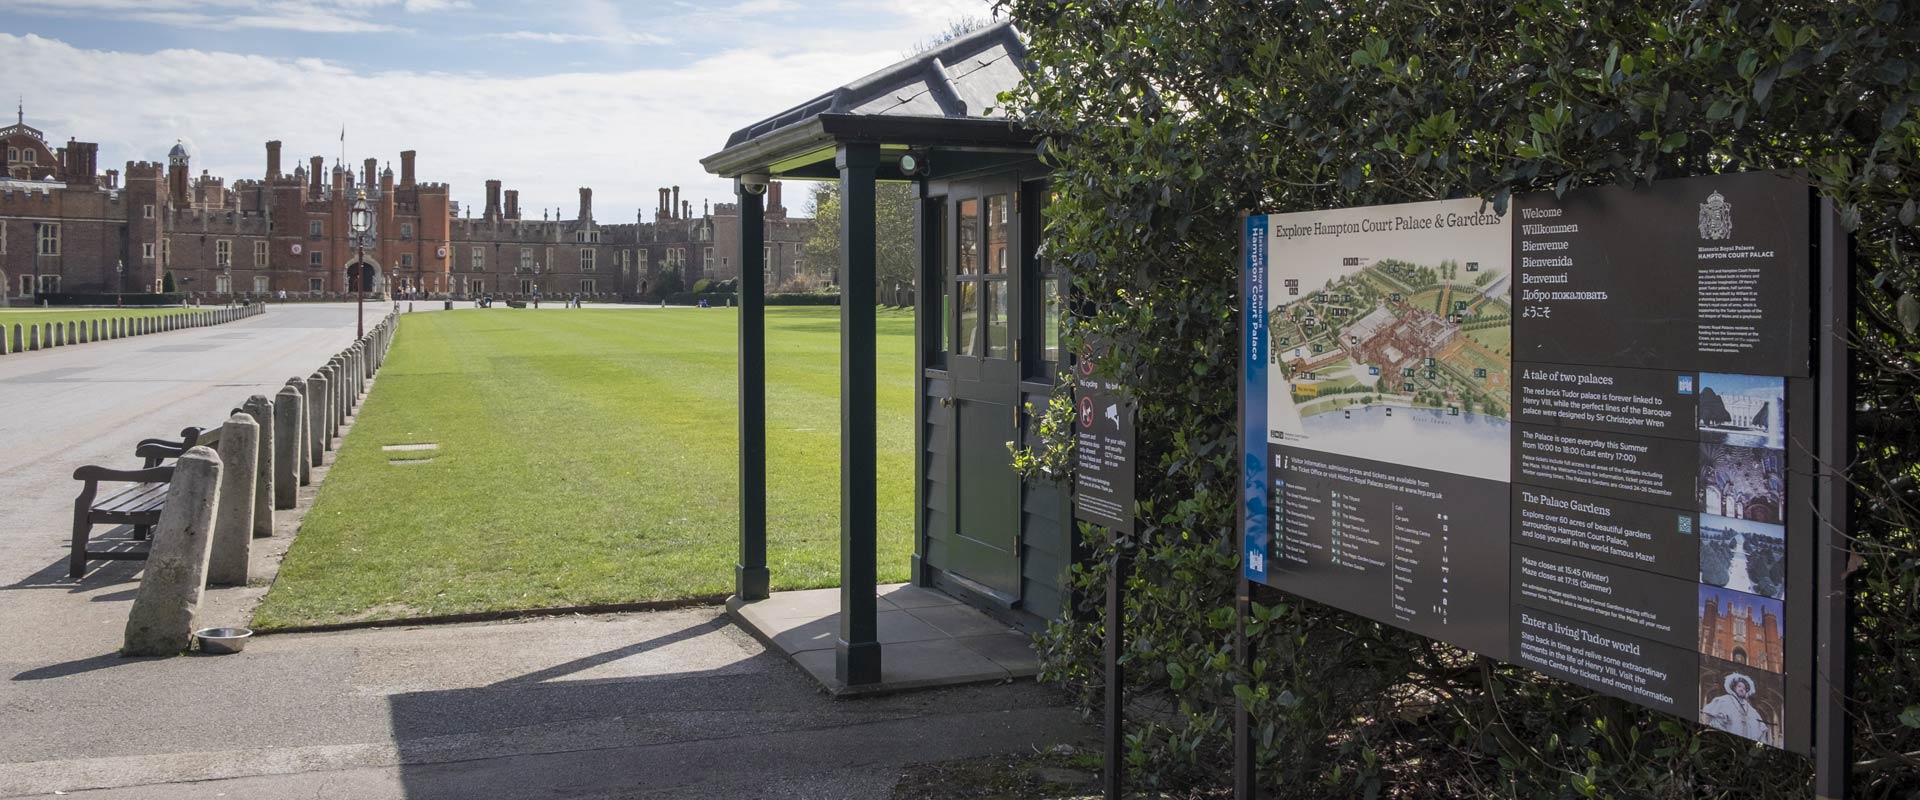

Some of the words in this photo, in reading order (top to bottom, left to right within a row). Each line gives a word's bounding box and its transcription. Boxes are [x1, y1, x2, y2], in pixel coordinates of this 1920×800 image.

[1522, 208, 1562, 219] Welcome
[1277, 224, 1312, 240] Explore
[1314, 222, 1359, 237] Hampton
[1362, 219, 1392, 232] Court
[1395, 216, 1432, 230] Palace
[1435, 214, 1444, 228] &
[1447, 212, 1501, 227] Gardens
[1522, 224, 1578, 235] Willkommen
[1522, 241, 1568, 251] Bienvenue
[1522, 256, 1573, 267] Bienvenida
[1522, 272, 1568, 283] Benvenuti
[1522, 290, 1550, 302] Добро
[1552, 291, 1607, 300] пожаловать
[1522, 306, 1551, 318] ようこそ
[1523, 369, 1530, 379] A
[1532, 370, 1548, 380] tale
[1549, 371, 1558, 381] of
[1560, 373, 1576, 382] two
[1578, 374, 1613, 386] palaces
[1546, 388, 1560, 397] brick
[1562, 390, 1579, 398] Tudor
[1581, 392, 1600, 400] palace
[1608, 394, 1632, 402] forever
[1633, 396, 1653, 404] linked
[1522, 397, 1540, 407] Henry
[1582, 403, 1604, 411] perfect
[1605, 404, 1620, 412] lines
[1643, 407, 1672, 418] Baroque
[1558, 410, 1586, 420] designed
[1587, 412, 1594, 422] by
[1596, 413, 1604, 421] Sir
[1606, 414, 1644, 426] Christopher
[1646, 417, 1664, 427] Wren
[1523, 442, 1536, 450] from
[1538, 443, 1554, 452] 10:00
[1563, 446, 1579, 455] 18:00
[1581, 448, 1596, 457] (Last
[1598, 452, 1614, 461] entry
[1616, 452, 1636, 462] 17:00)
[1535, 433, 1553, 441] Palace
[1577, 439, 1605, 449] everyday
[1607, 441, 1618, 449] this
[1620, 442, 1648, 452] Summer
[1522, 492, 1538, 504] The
[1540, 495, 1569, 509] Palace
[1570, 500, 1610, 516] Gardens
[1522, 510, 1544, 520] Explore
[1560, 516, 1568, 524] 60
[1569, 520, 1585, 528] acres
[1595, 522, 1622, 534] beautiful
[1624, 529, 1651, 539] gardens
[1522, 522, 1557, 534] surrounding
[1558, 526, 1586, 538] Hampton
[1587, 531, 1605, 541] Court
[1534, 532, 1546, 541] lose
[1547, 536, 1571, 546] yourself
[1579, 541, 1589, 549] the
[1591, 544, 1609, 553] world
[1610, 546, 1634, 558] famous
[1522, 558, 1537, 567] Maze
[1538, 561, 1556, 571] closes
[1565, 566, 1581, 576] 15:45
[1582, 570, 1609, 583] (Winter)
[1522, 568, 1537, 577] Maze
[1538, 572, 1556, 581] closes
[1565, 577, 1579, 586] 17:15
[1580, 580, 1612, 594] (Summer)
[1522, 615, 1546, 630] Enter
[1555, 623, 1580, 641] living
[1581, 630, 1610, 647] Tudor
[1612, 641, 1640, 655] world
[1521, 644, 1548, 656] moments
[1556, 652, 1565, 661] the
[1567, 655, 1576, 664] life
[1585, 660, 1604, 674] Henry
[1619, 670, 1633, 680] Visit
[1635, 675, 1646, 684] the
[1522, 632, 1534, 644] Step
[1536, 636, 1549, 646] back
[1558, 642, 1571, 652] time
[1585, 651, 1602, 660] relive
[1603, 656, 1621, 665] some
[1622, 661, 1667, 679] extraordinary
[1521, 652, 1547, 666] Welcome
[1549, 660, 1568, 672] Centre
[1570, 666, 1578, 675] for
[1580, 670, 1600, 682] tickets
[1601, 677, 1613, 686] and
[1615, 681, 1632, 691] more
[1634, 684, 1673, 703] information
